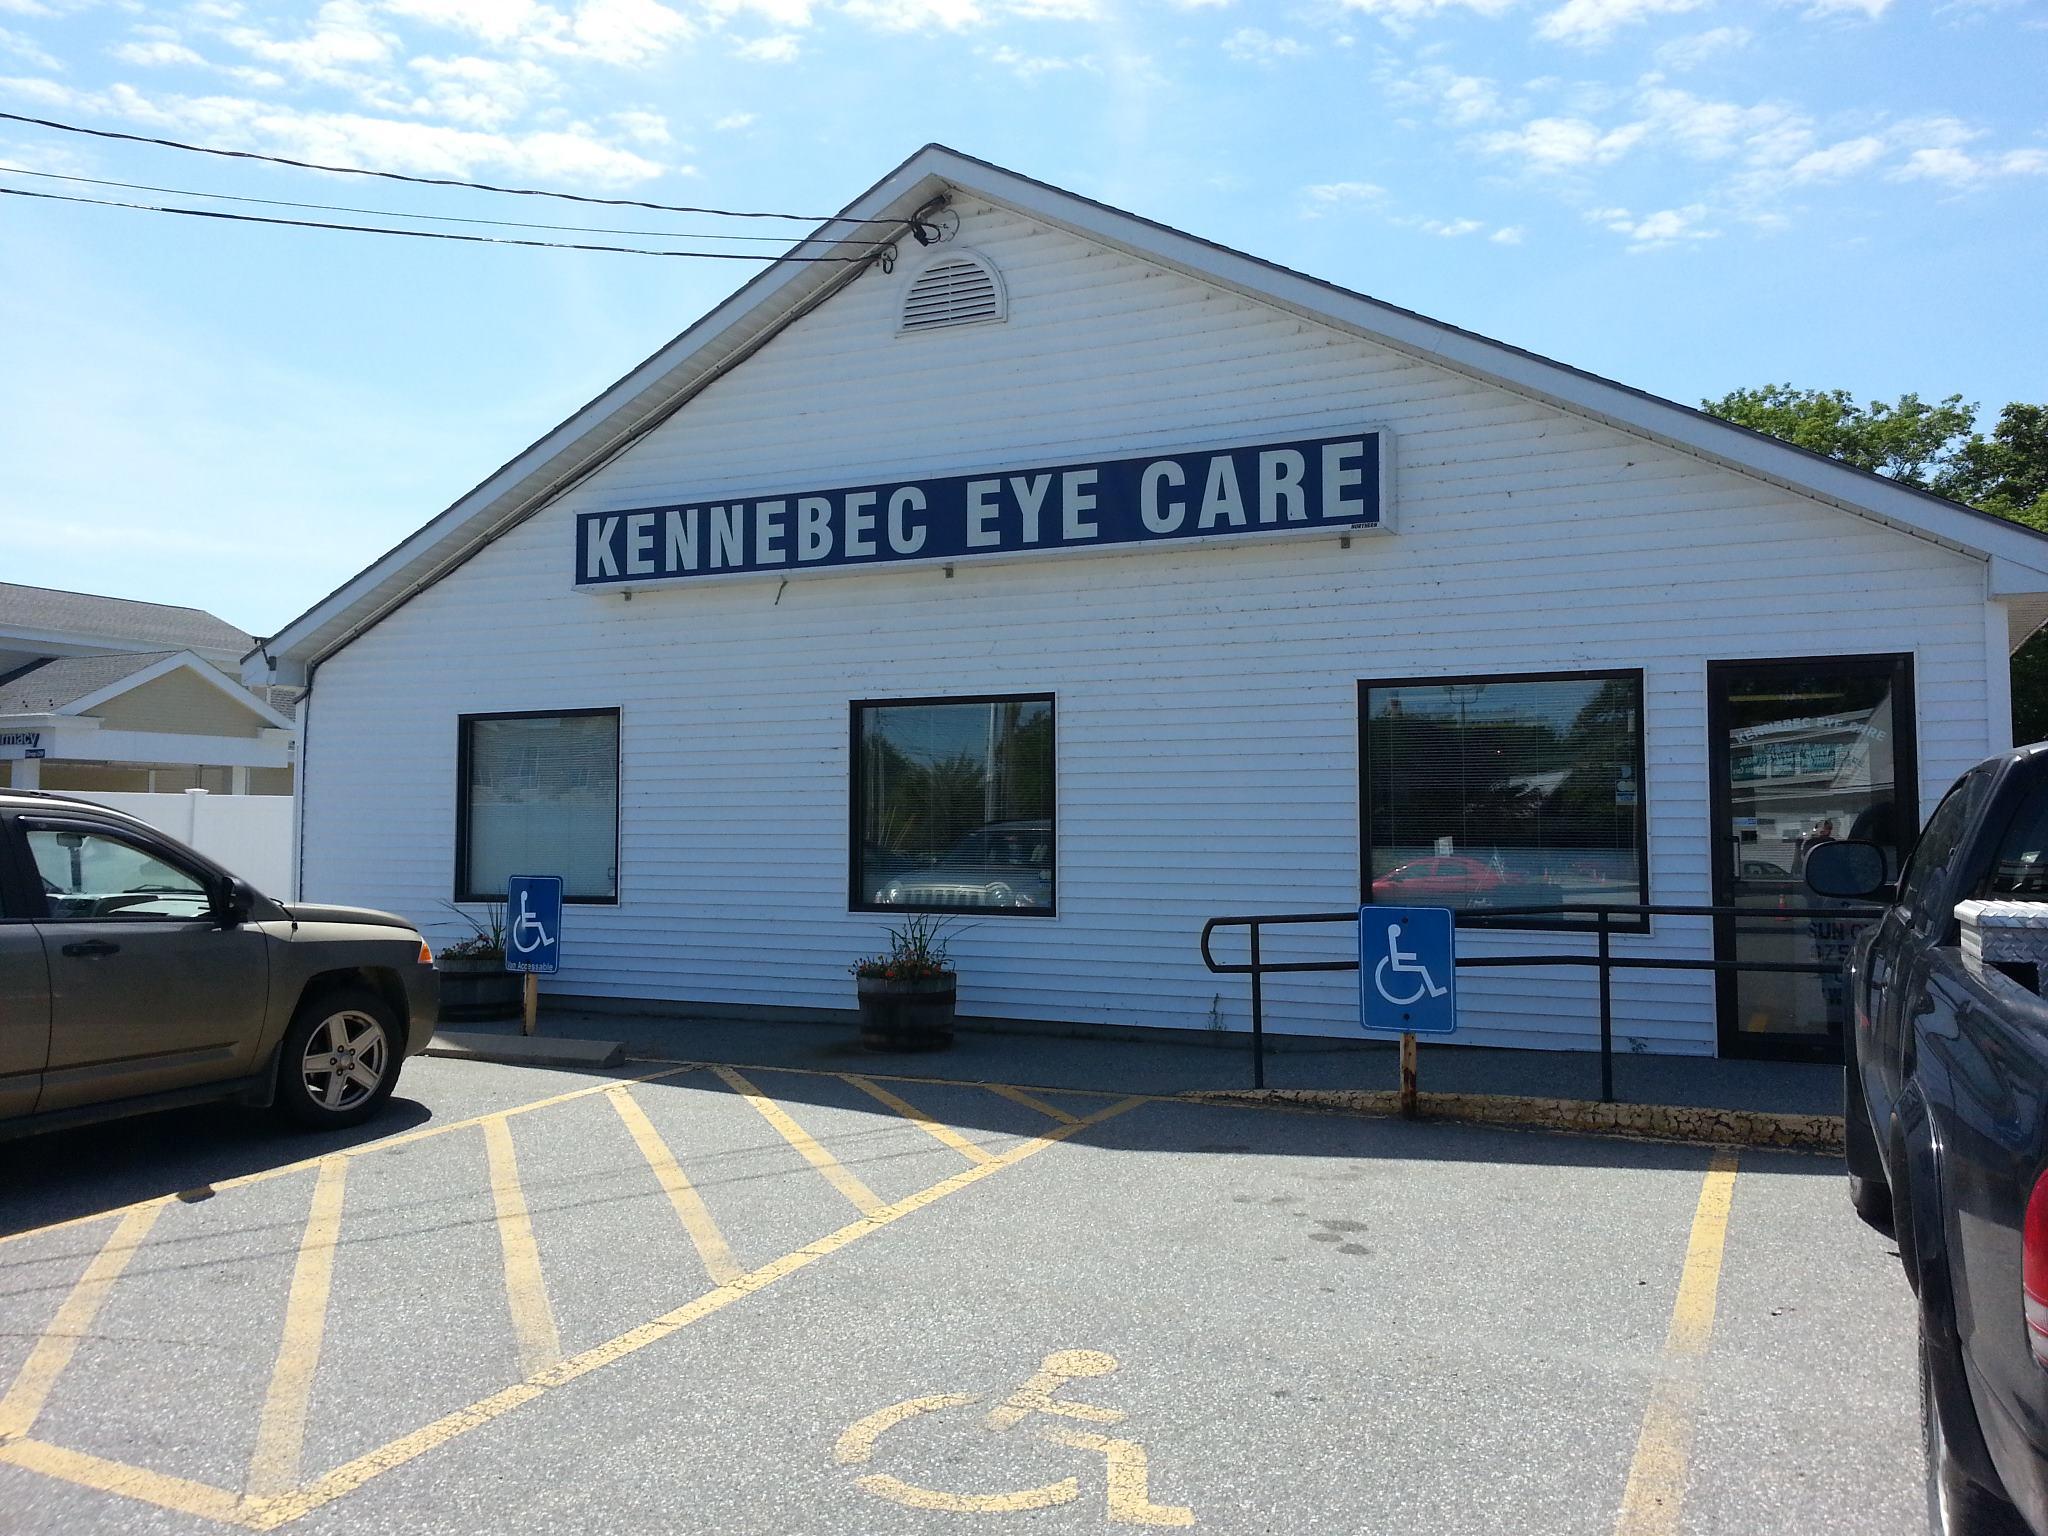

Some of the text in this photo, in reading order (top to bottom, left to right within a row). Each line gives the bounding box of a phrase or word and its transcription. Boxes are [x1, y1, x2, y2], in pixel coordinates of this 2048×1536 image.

[586, 441, 1364, 578] KENNEBEC EYE CARE
